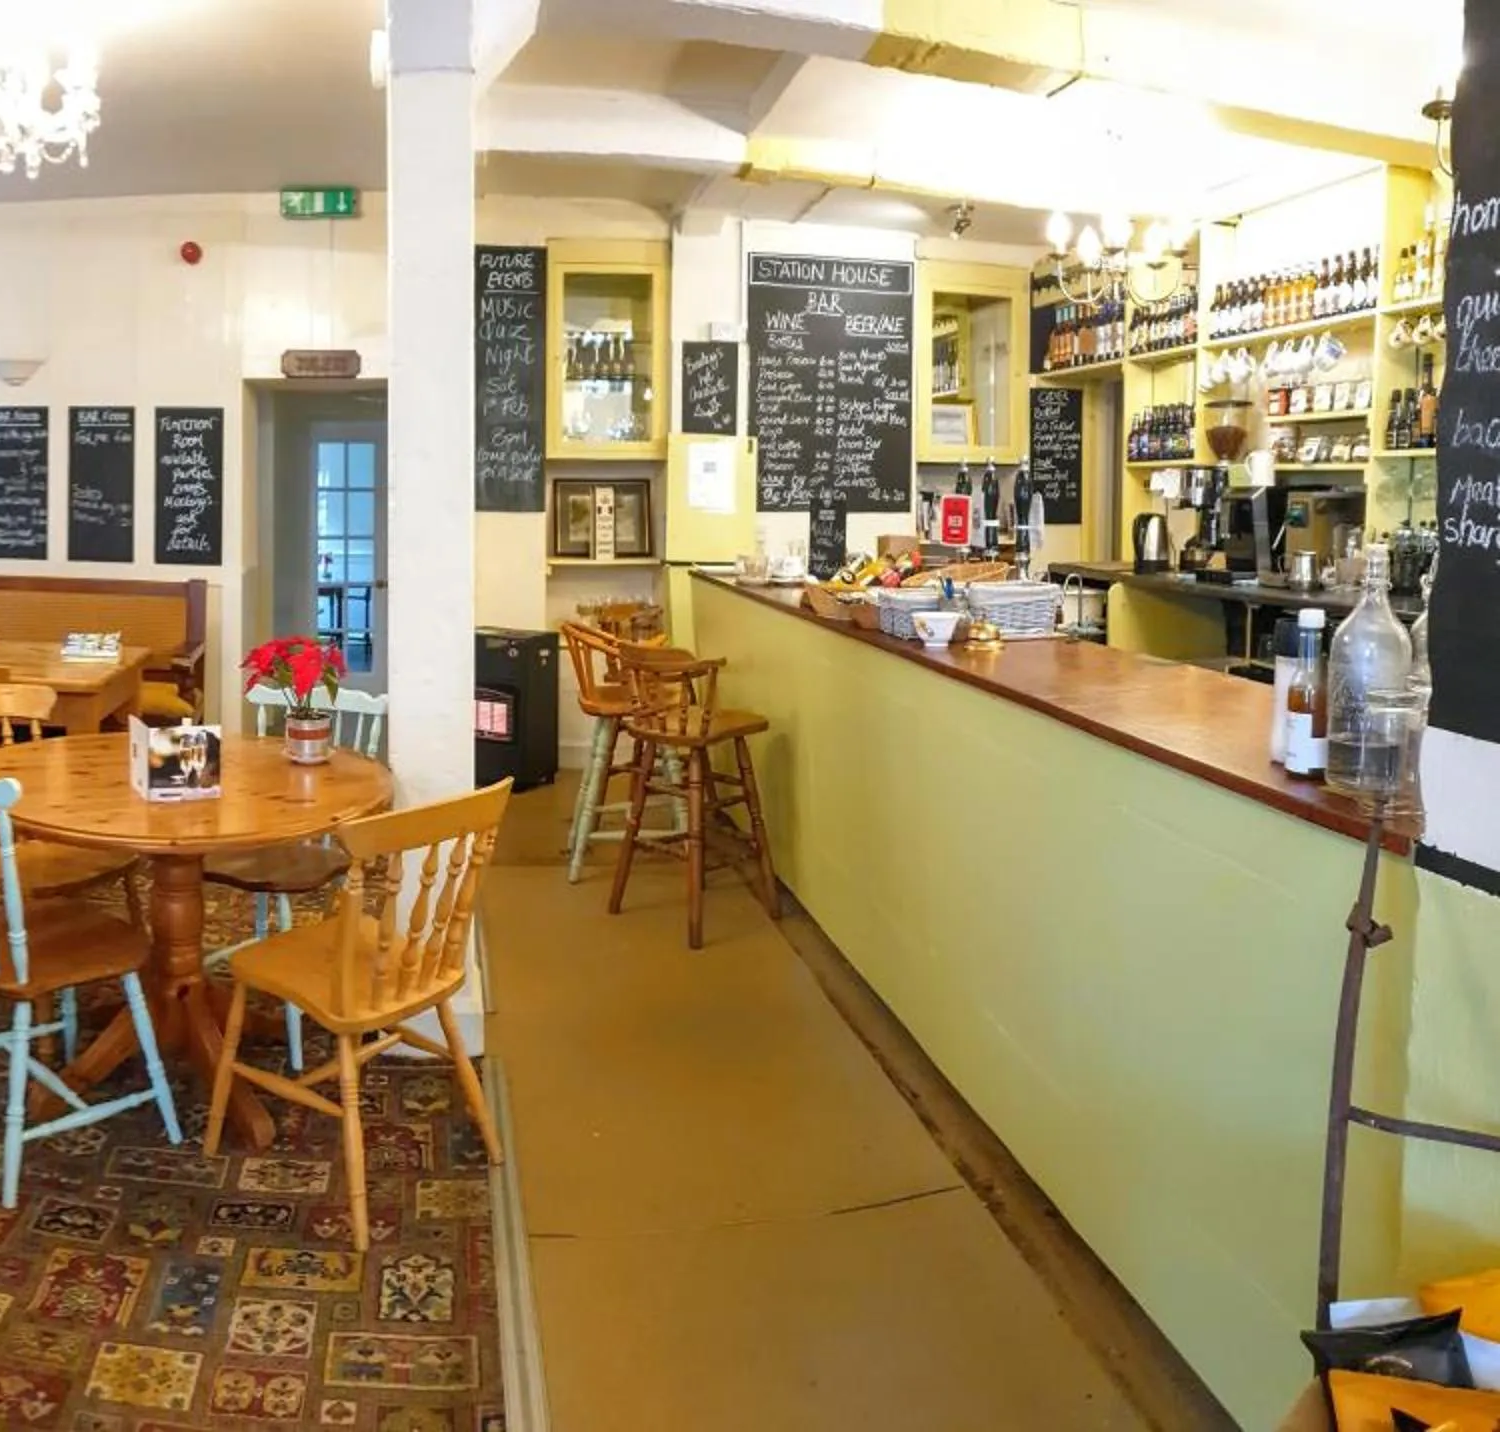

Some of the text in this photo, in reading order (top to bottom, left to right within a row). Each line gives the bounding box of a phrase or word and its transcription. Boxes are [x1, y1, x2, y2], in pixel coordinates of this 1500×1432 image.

[480, 252, 534, 269] FUTURE
[757, 259, 895, 287] STATION HOUSE
[807, 291, 844, 314] BAR
[765, 310, 805, 331] WINE
[485, 343, 536, 376] Night
[864, 435, 883, 450] Bar
